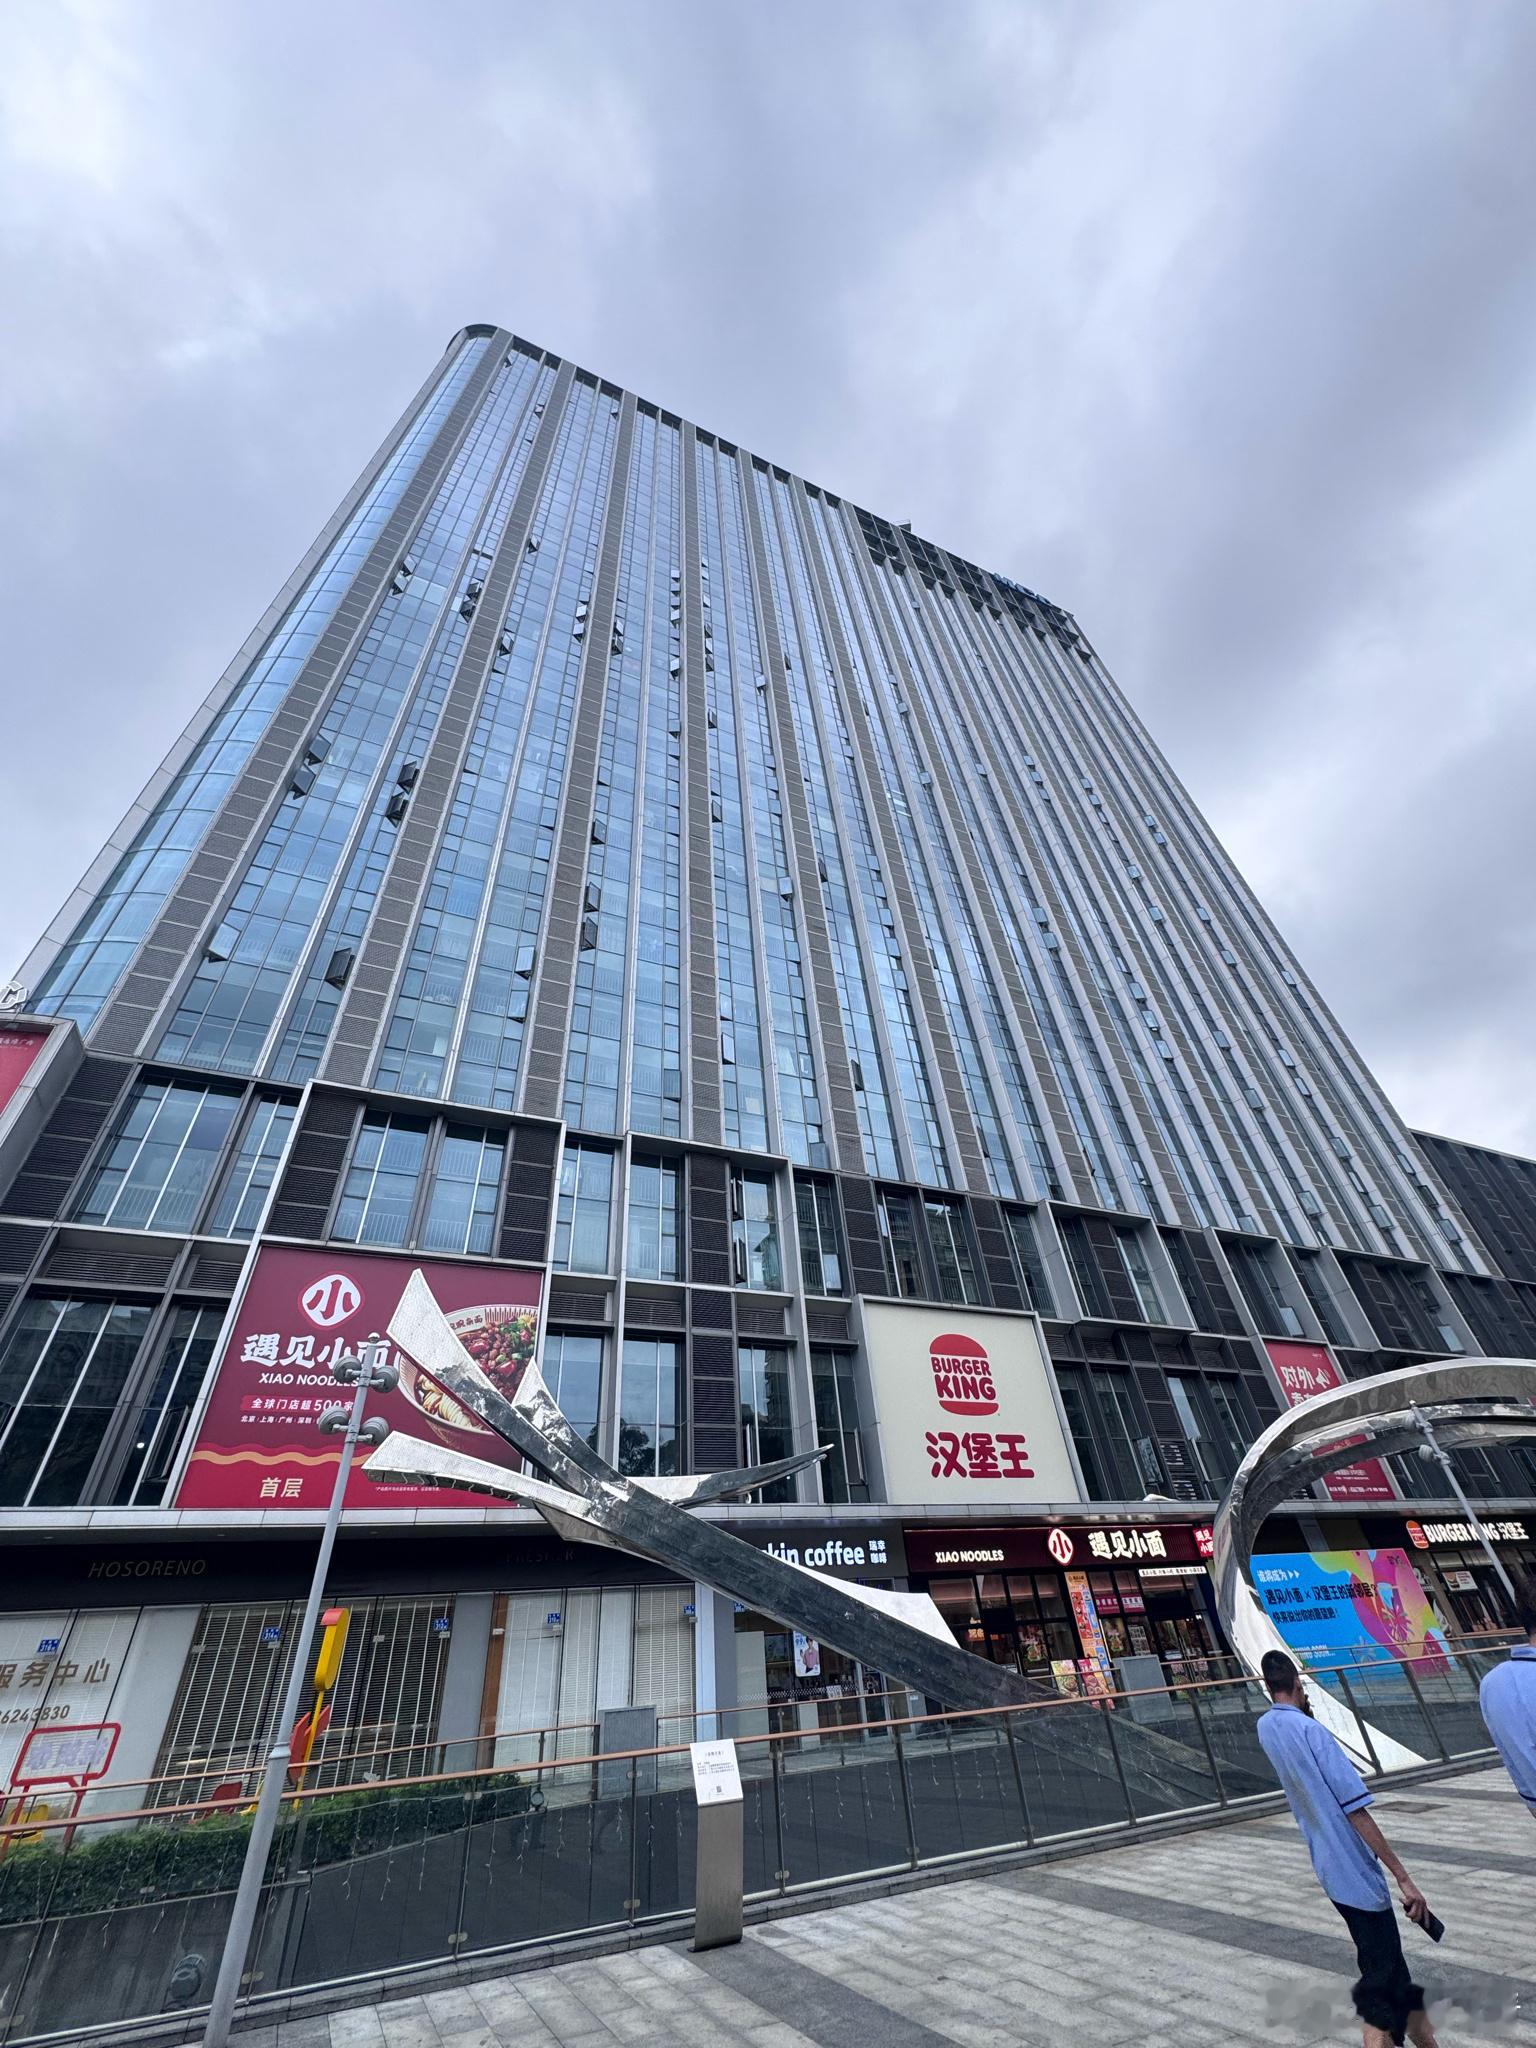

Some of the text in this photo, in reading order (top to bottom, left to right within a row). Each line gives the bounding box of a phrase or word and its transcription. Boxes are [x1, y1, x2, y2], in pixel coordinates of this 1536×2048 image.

[306, 1278, 355, 1320] 小
[240, 1333, 391, 1370] 遇见小面
[931, 1356, 992, 1376] BURGER
[1280, 1366, 1316, 1390] 对外
[259, 1373, 293, 1385] XIAO
[934, 1374, 996, 1400] KING
[925, 1431, 1035, 1478] 汉堡王
[260, 1477, 303, 1498] 首层
[1422, 1522, 1529, 1542] BURGER KNG 汉堡王
[804, 1540, 865, 1567] coffee
[935, 1549, 1004, 1563] XIAO NOODLES
[1088, 1530, 1167, 1560] 遇见小面
[0, 1704, 70, 1724] 6243830
